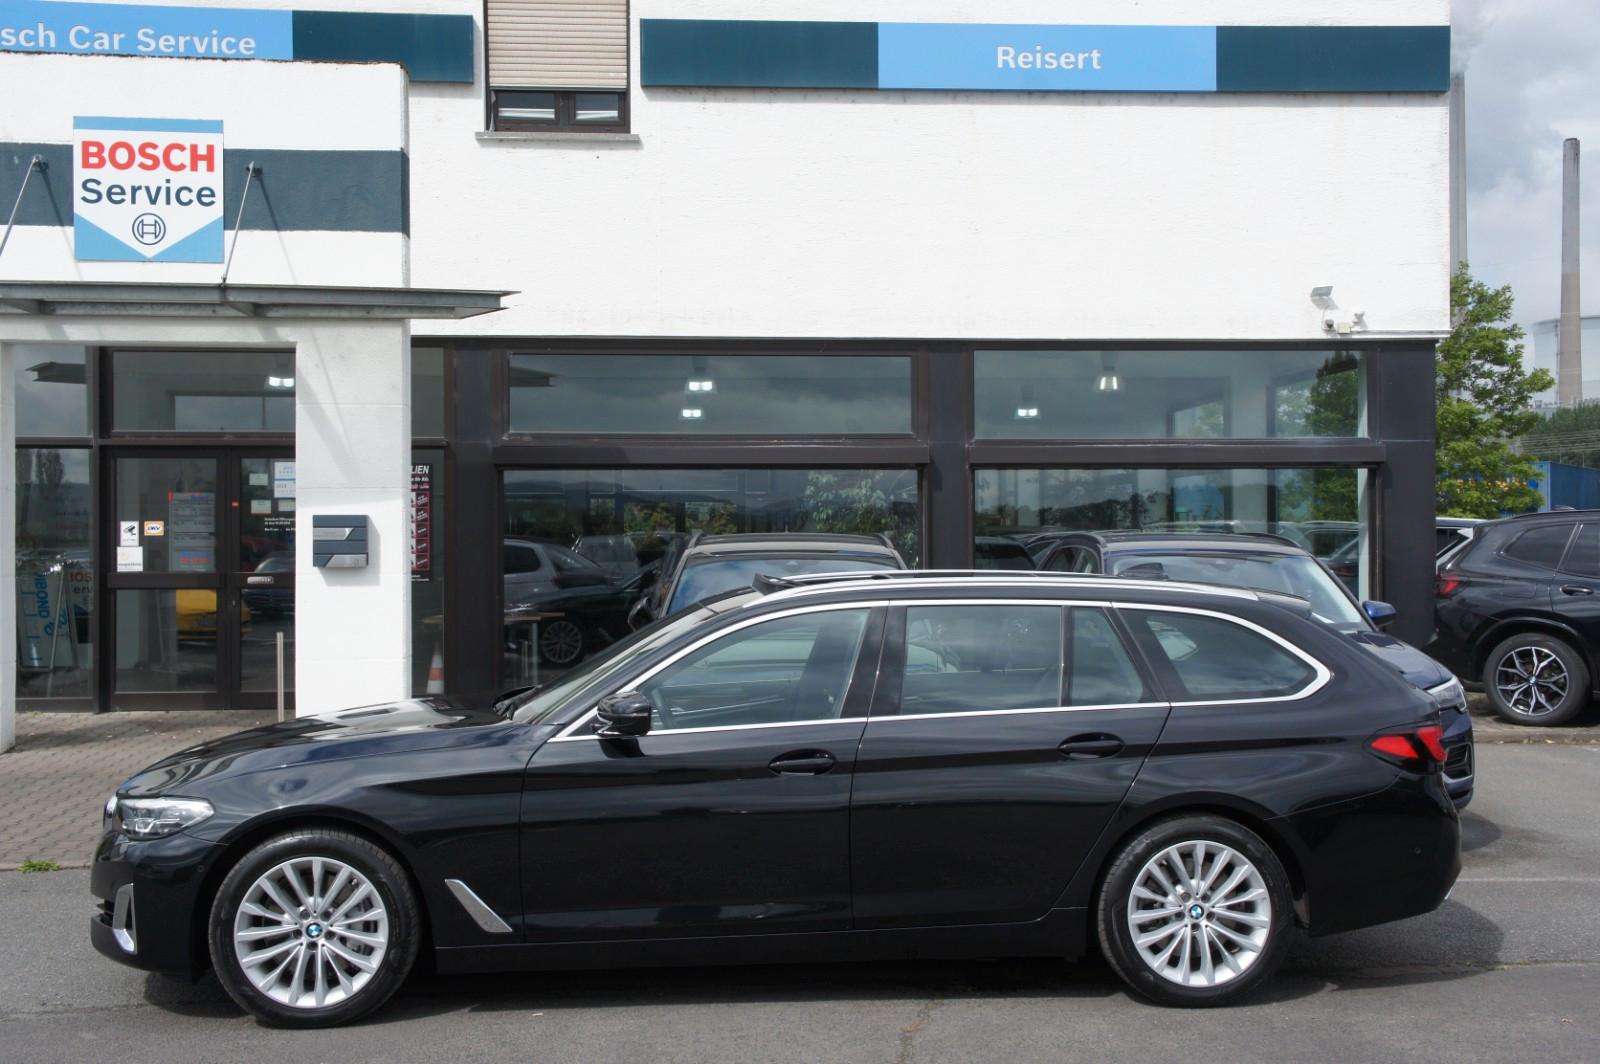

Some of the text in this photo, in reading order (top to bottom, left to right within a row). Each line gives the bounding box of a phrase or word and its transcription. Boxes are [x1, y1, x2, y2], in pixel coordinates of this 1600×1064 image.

[0, 22, 257, 55] sch Car Service
[996, 45, 1102, 70] Reisert
[80, 140, 216, 173] BOSCH
[80, 178, 217, 207] Service
